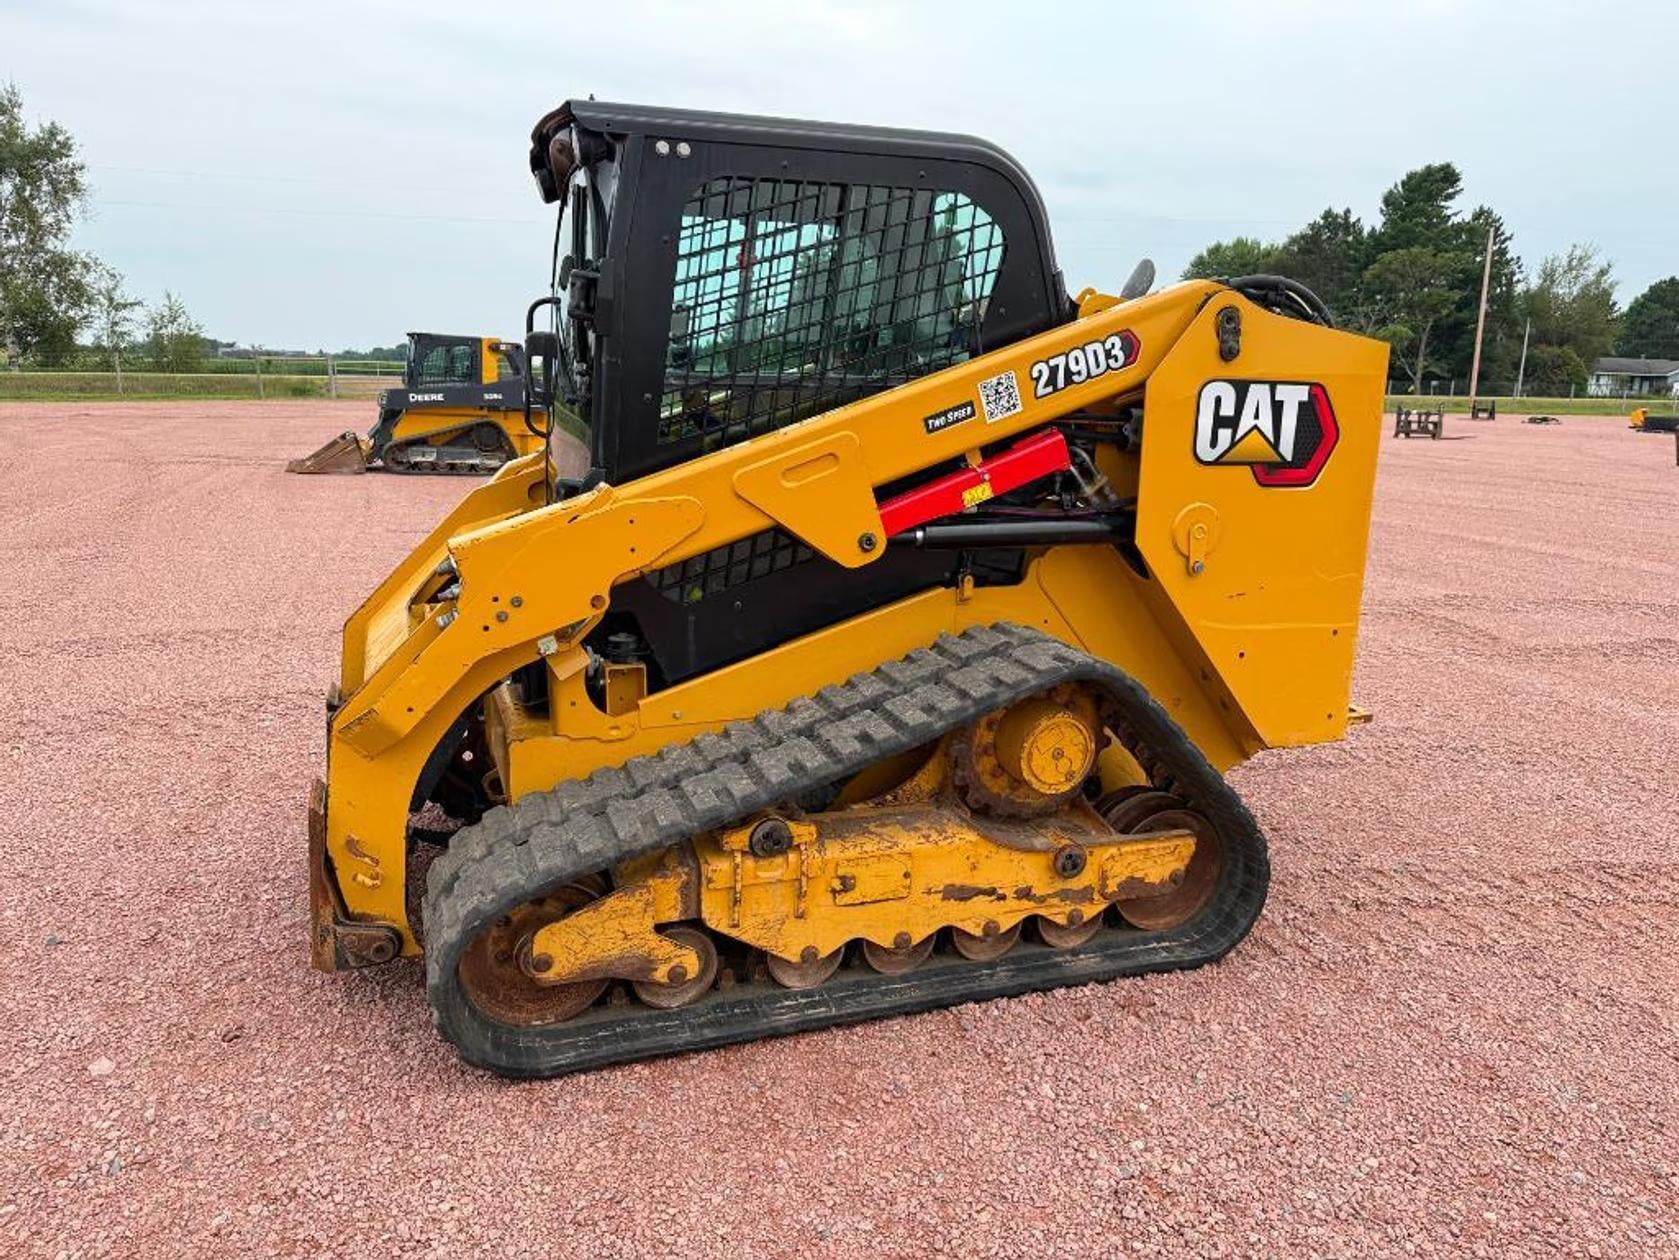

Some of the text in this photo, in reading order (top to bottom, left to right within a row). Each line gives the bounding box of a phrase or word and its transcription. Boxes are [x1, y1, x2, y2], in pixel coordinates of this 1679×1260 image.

[408, 392, 444, 402] DEERE
[1031, 335, 1125, 397] 279D3
[1196, 380, 1311, 463] CAT
